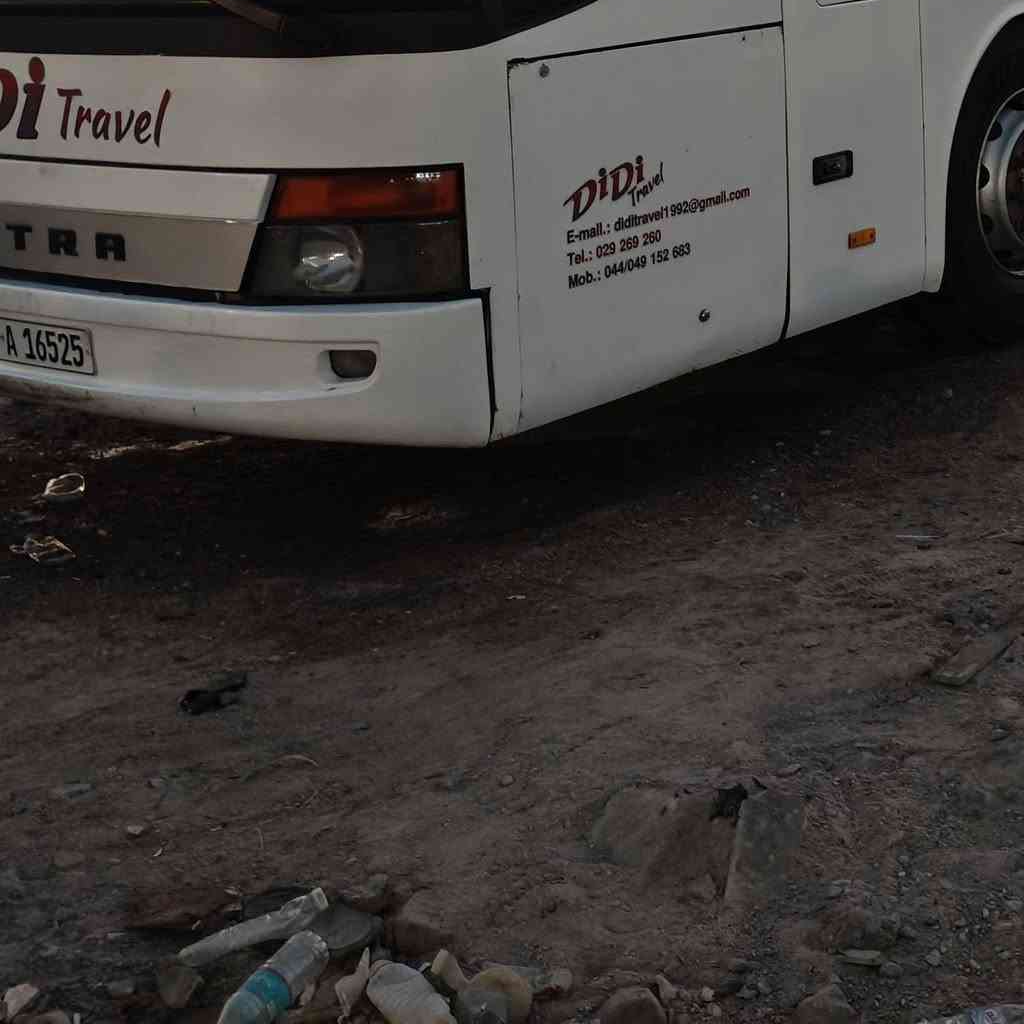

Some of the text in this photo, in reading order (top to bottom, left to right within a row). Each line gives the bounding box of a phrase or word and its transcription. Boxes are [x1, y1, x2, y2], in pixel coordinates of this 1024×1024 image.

[56, 88, 171, 148] Travel
[563, 155, 645, 222] DiDi
[627, 161, 664, 206] Travel
[567, 229, 662, 266] Tel.: 029 269 260
[568, 270, 601, 289] Mob.:
[604, 255, 647, 279] 044/049
[651, 248, 669, 265] 152
[23, 327, 84, 367] 16525
